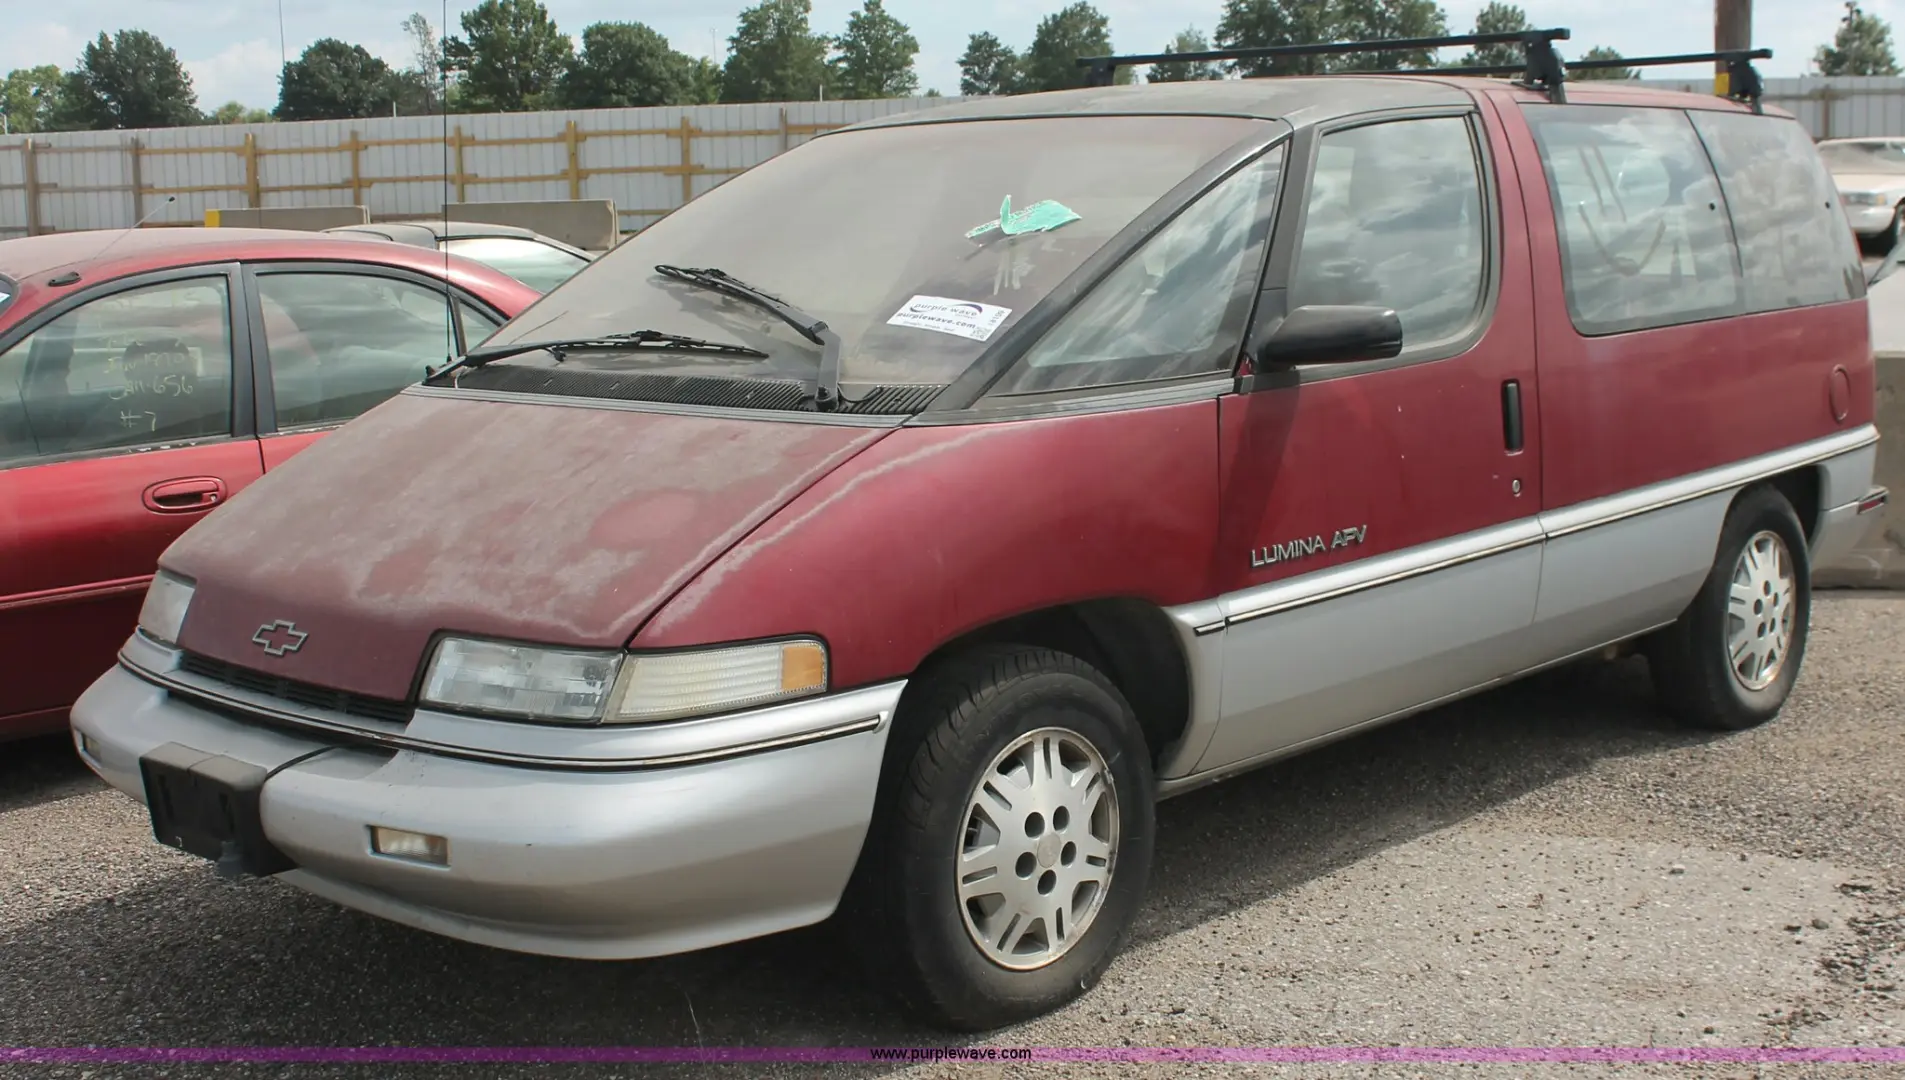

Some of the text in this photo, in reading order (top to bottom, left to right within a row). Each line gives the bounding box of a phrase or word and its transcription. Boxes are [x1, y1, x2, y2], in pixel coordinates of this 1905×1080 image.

[914, 303, 978, 316] purple wave
[896, 312, 977, 329] purplewave.com
[1251, 524, 1367, 567] LUMINA APV
